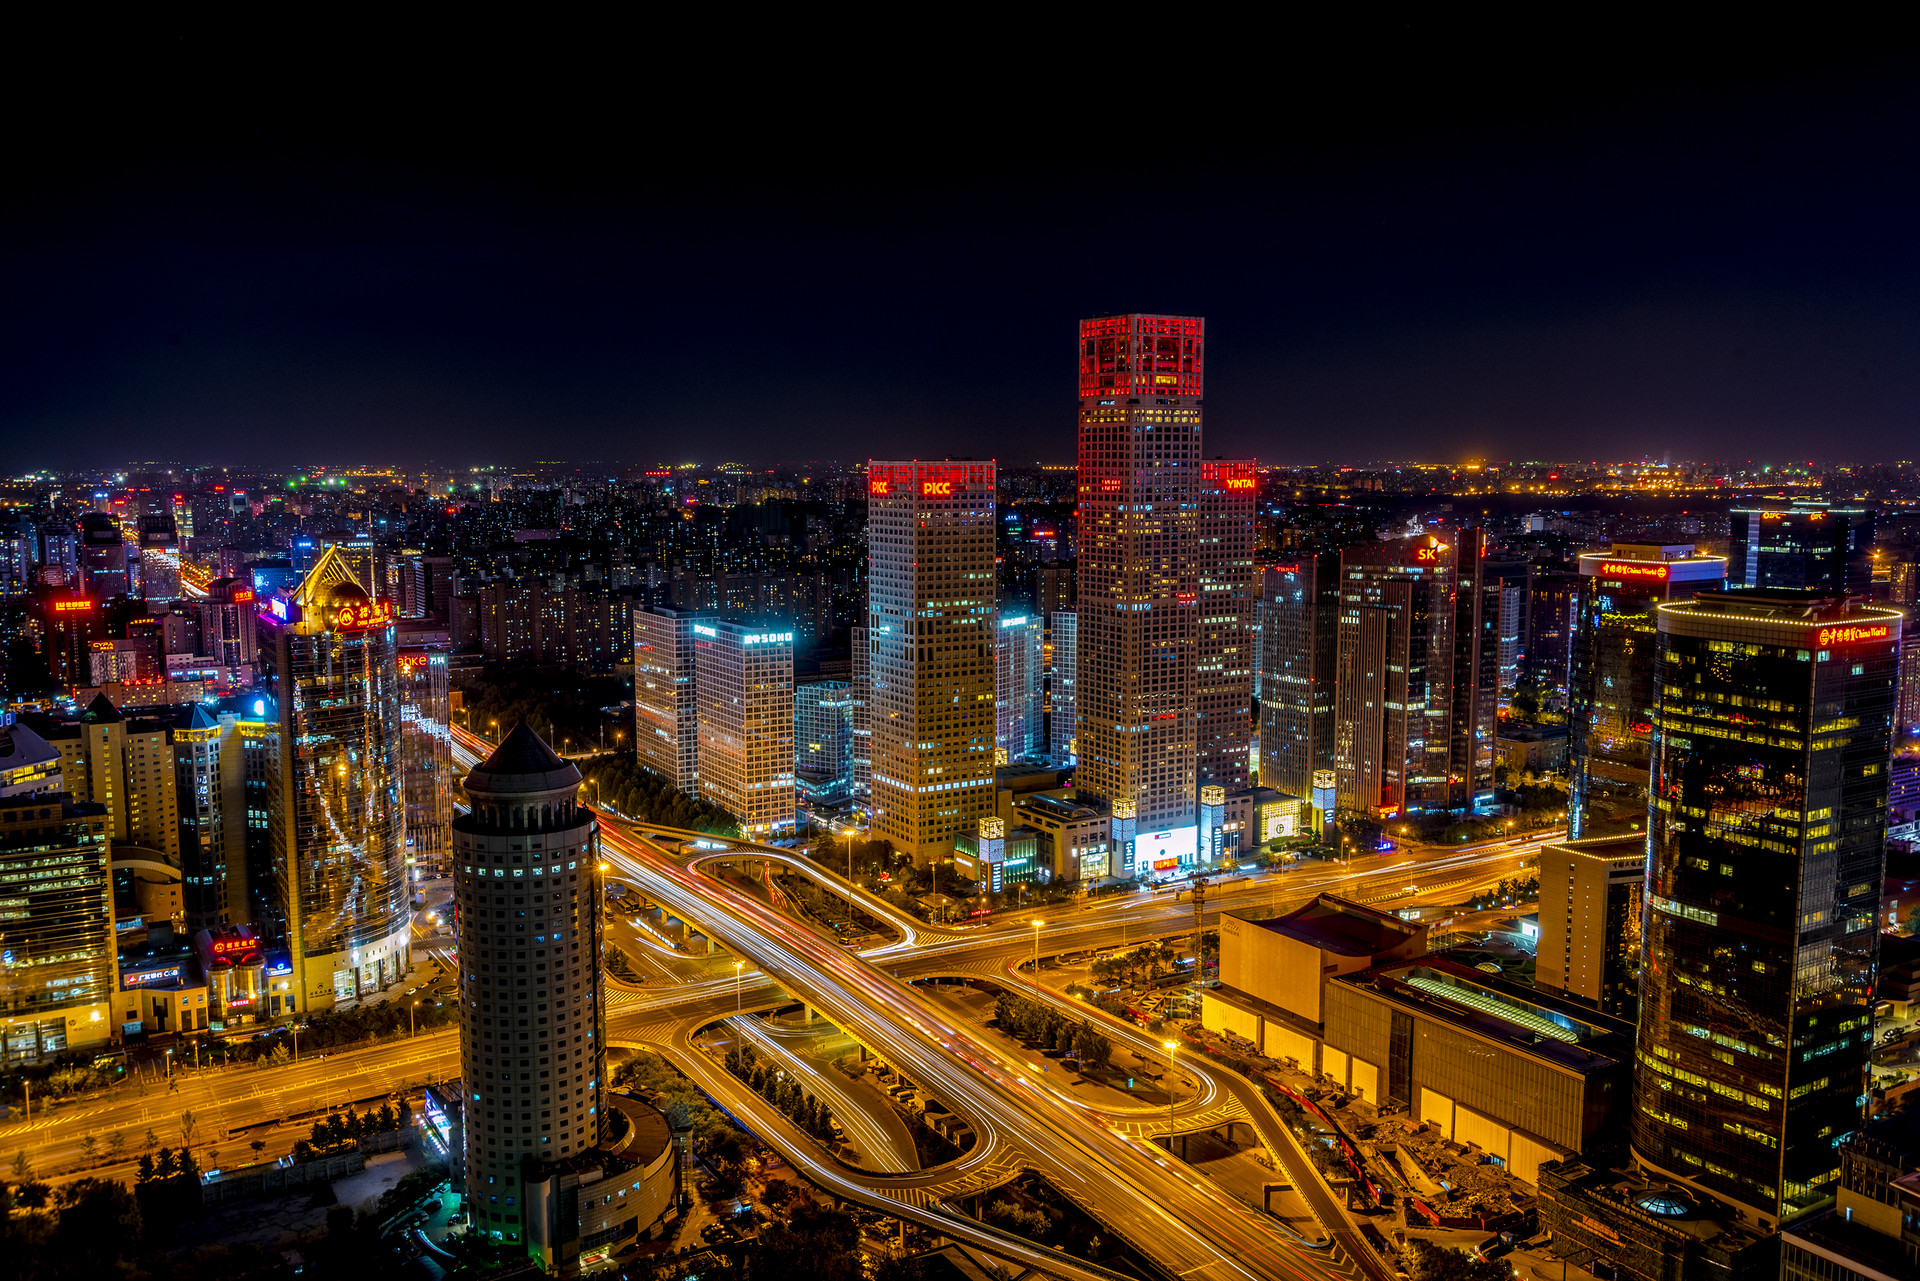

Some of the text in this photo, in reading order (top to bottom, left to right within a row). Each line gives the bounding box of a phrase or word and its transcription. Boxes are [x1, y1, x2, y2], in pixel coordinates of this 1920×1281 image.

[872, 481, 887, 494] PICC
[923, 482, 951, 495] PICC
[1227, 479, 1255, 489] YINTAI
[1418, 549, 1436, 560] SK
[1855, 629, 1870, 639] China
[1870, 627, 1887, 636] World
